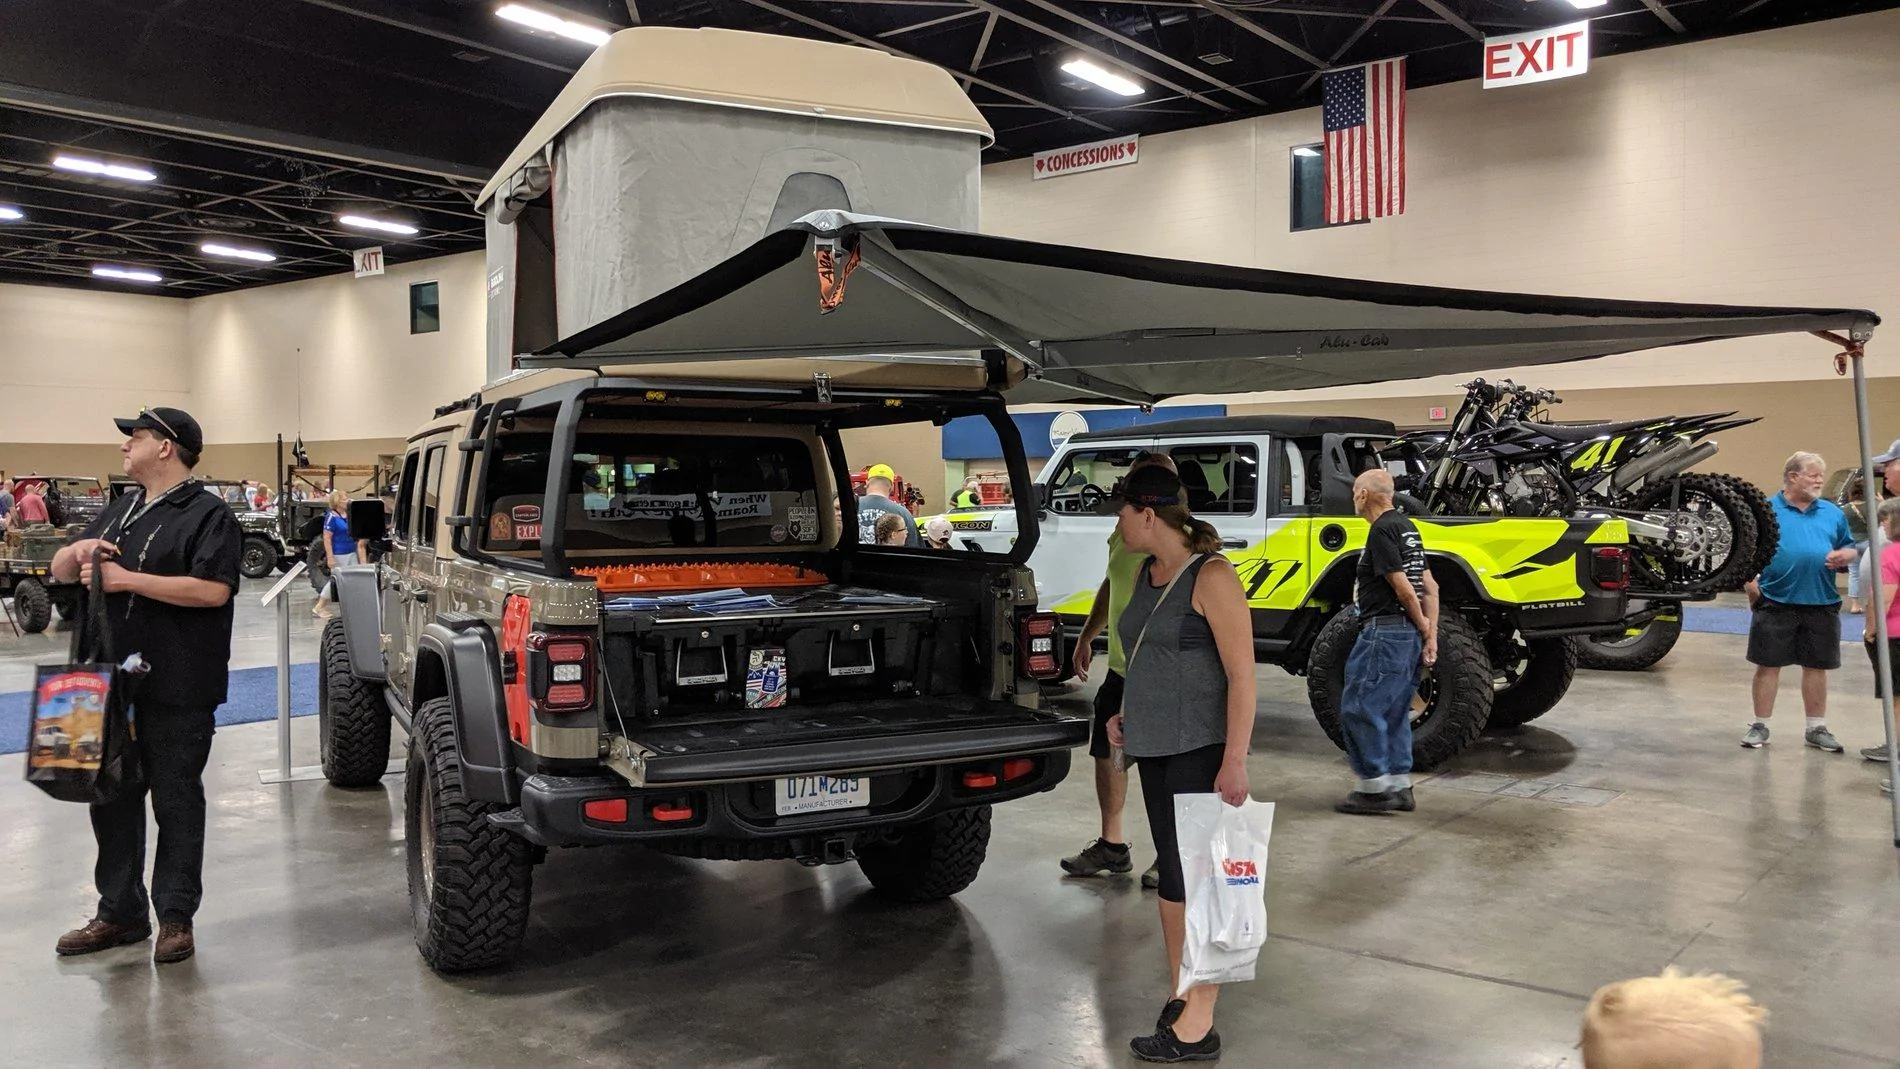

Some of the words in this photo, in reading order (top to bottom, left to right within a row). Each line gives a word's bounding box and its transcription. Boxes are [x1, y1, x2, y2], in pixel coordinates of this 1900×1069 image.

[1485, 31, 1584, 80] EXIT
[1047, 143, 1125, 172] CONCESSIONS
[358, 251, 381, 272] XIT
[1570, 435, 1626, 472] 41
[517, 525, 543, 538] EXPL
[952, 521, 990, 530] ICON
[1521, 600, 1586, 611] FLATBILL
[798, 798, 849, 811] MANUFACTURER
